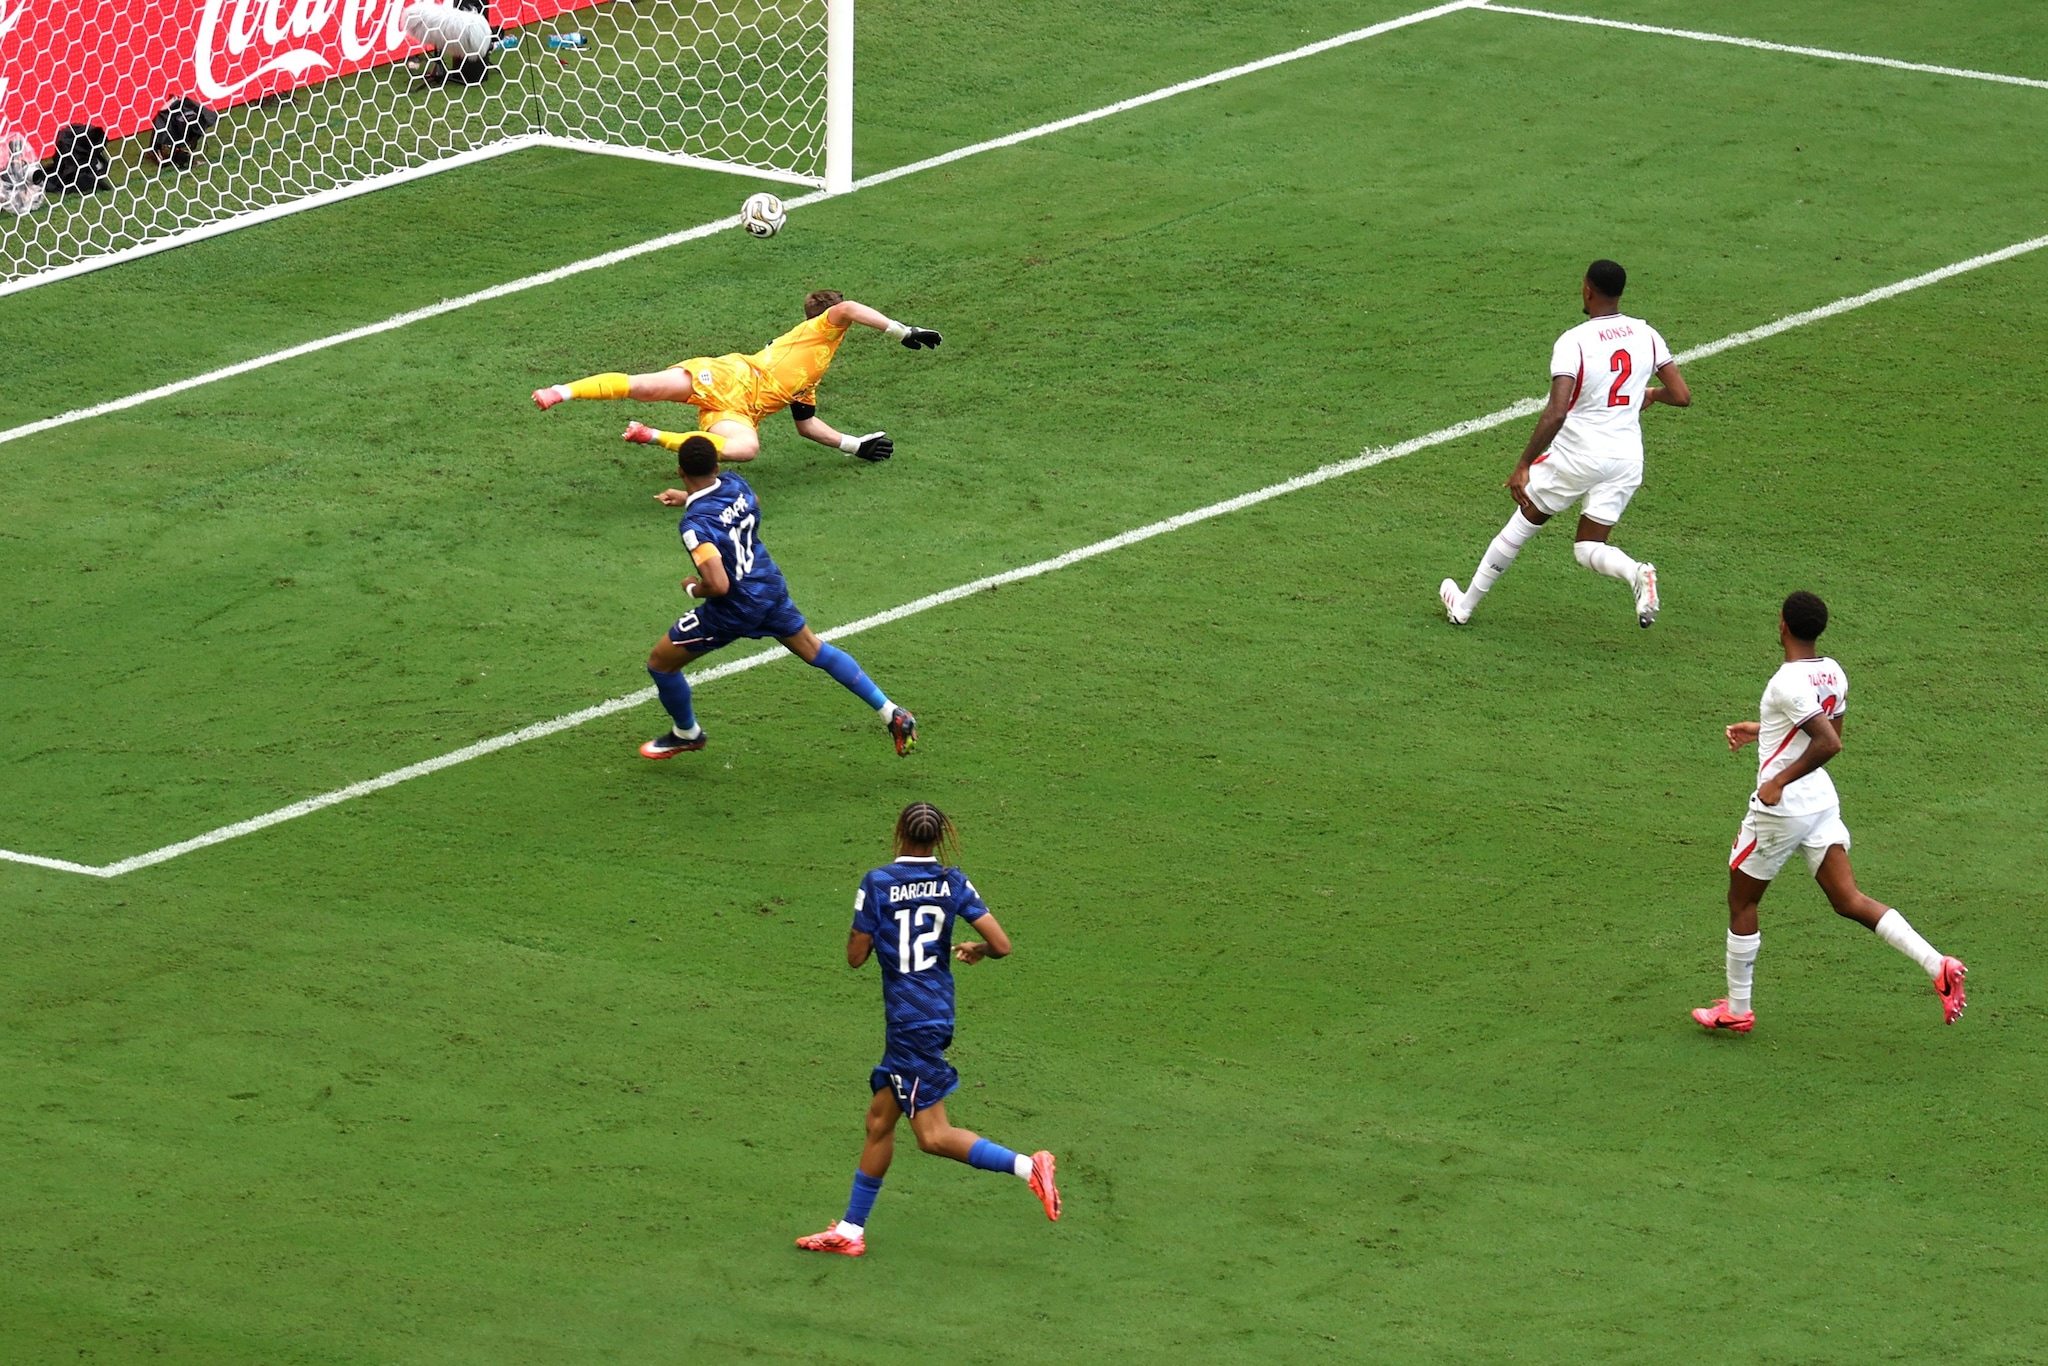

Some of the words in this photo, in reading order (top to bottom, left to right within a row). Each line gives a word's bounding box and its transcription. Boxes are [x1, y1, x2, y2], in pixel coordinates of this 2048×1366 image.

[1598, 325, 1634, 341] KONSA
[1608, 348, 1632, 407] 2
[728, 513, 755, 581] 10
[889, 880, 951, 902] BARCOLA
[894, 905, 946, 974] 12
